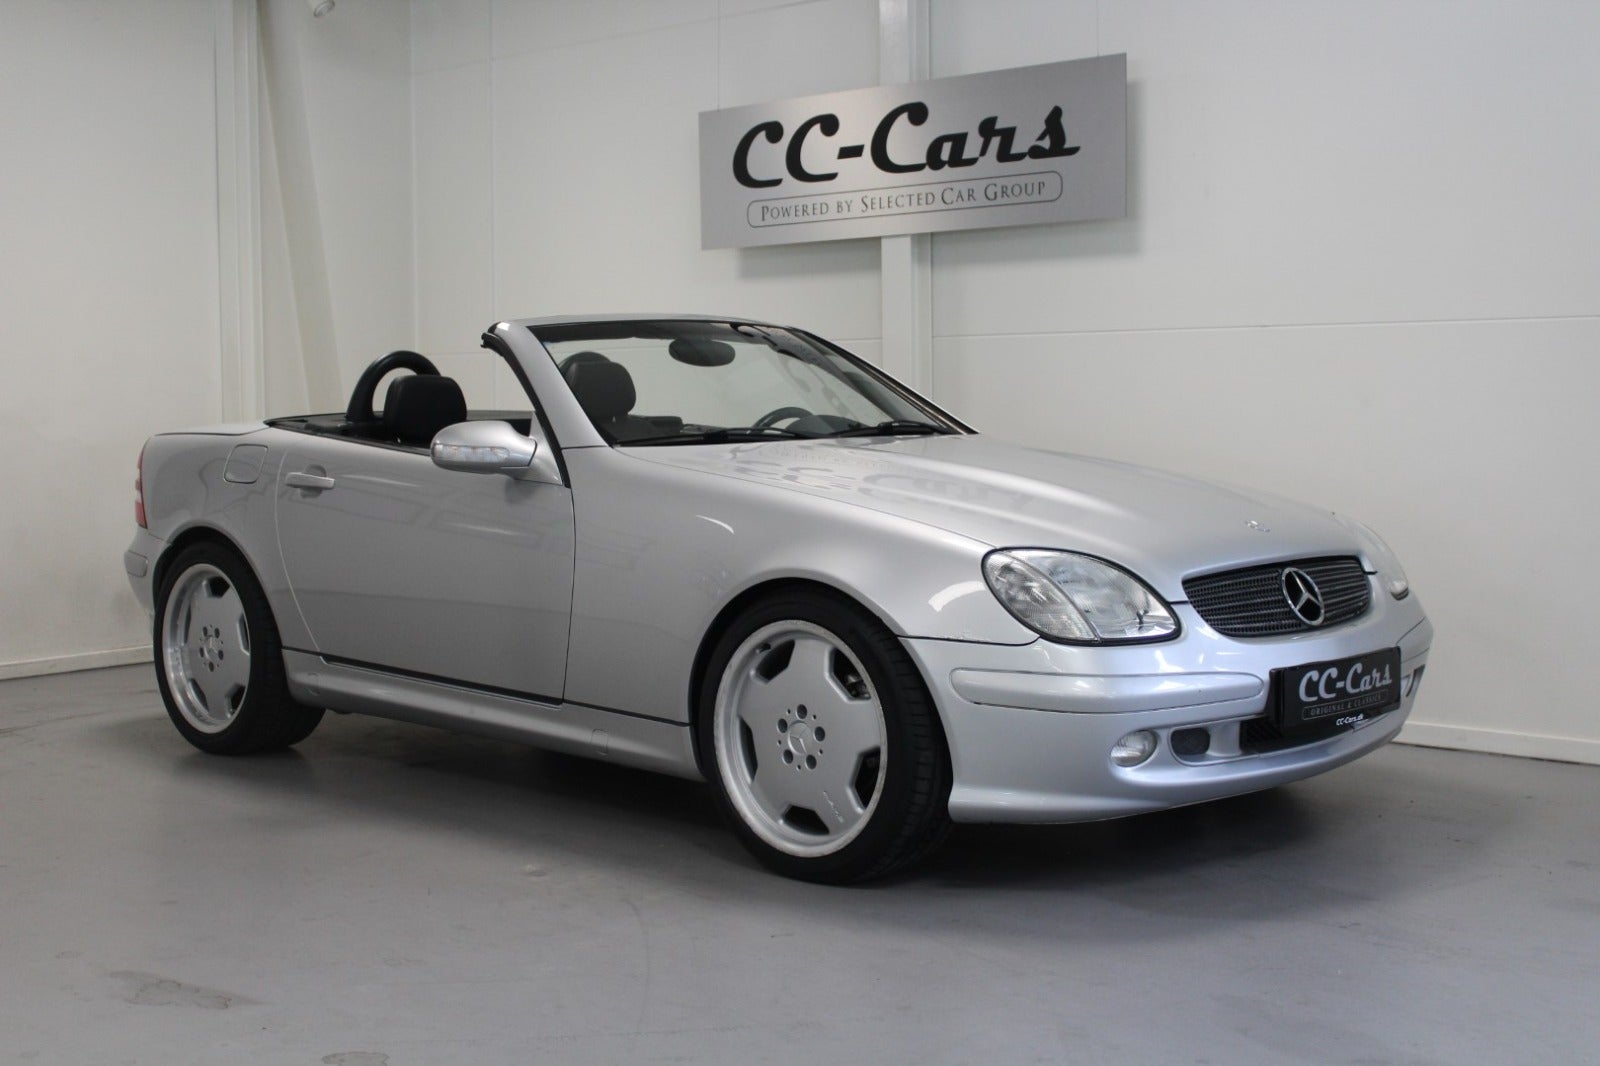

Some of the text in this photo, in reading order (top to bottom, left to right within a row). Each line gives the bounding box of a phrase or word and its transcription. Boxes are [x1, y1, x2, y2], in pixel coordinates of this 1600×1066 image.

[733, 101, 1081, 188] CC-Cars
[1299, 662, 1393, 702] CC-Cars
[1310, 704, 1345, 715] ORIGINAL
